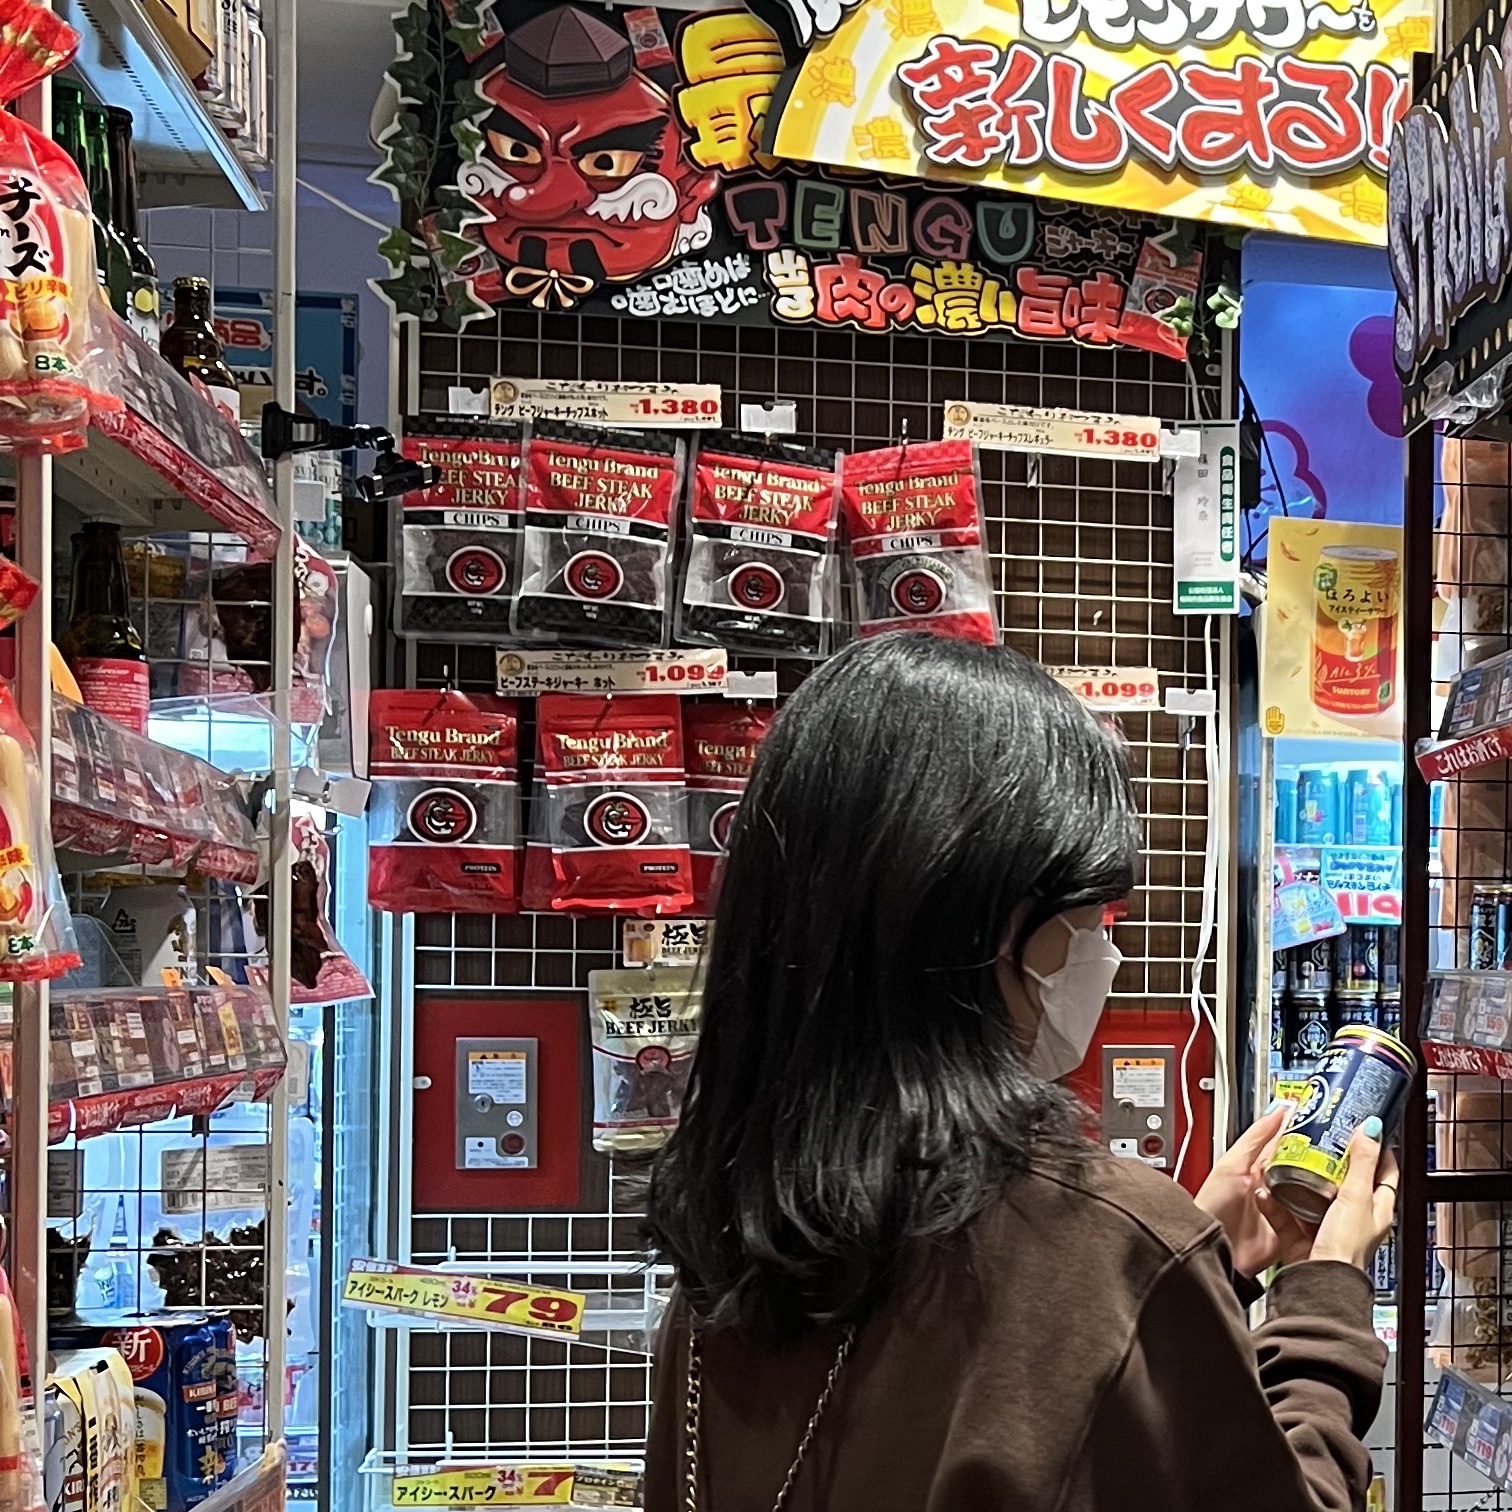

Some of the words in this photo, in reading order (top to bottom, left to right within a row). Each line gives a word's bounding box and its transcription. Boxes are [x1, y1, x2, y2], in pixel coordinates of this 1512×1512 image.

[2, 178, 53, 275] チーズ
[724, 179, 1034, 261] TENGU
[638, 398, 718, 415] 1,380
[1083, 428, 1157, 447] 1,380
[547, 451, 598, 471] Tengu
[604, 457, 658, 479] Brand
[550, 472, 592, 491] BEEF
[597, 479, 652, 498] STEAK
[766, 473, 822, 493] Brand
[908, 474, 959, 490] Brand
[451, 488, 509, 505] JERKY
[715, 485, 757, 504] BEEF
[760, 489, 813, 511] STEAK
[862, 500, 899, 515] BEEF
[904, 493, 956, 509] STEAK
[453, 513, 499, 525] CHIPS
[575, 517, 620, 532] CHIPS
[739, 507, 792, 526] JERKY
[886, 511, 938, 531] JERKY
[739, 529, 783, 544] CHIPS
[891, 538, 933, 549] CHIPS
[1326, 588, 1388, 602] ほろよい
[1081, 682, 1155, 697] 1,099
[1332, 686, 1370, 695] SUNTORY
[385, 726, 442, 746] Tengu
[445, 729, 501, 746] Brand
[556, 734, 612, 752] Tengu
[615, 731, 668, 749] Brand
[421, 747, 457, 761] STEAK
[460, 749, 494, 763] JERKY
[563, 754, 592, 767] BEEF
[630, 751, 664, 766] JERKY
[606, 1022, 644, 1034] BEEF
[422, 1291, 449, 1308] レモン
[486, 1291, 578, 1323] 79
[112, 1329, 152, 1363] 新
